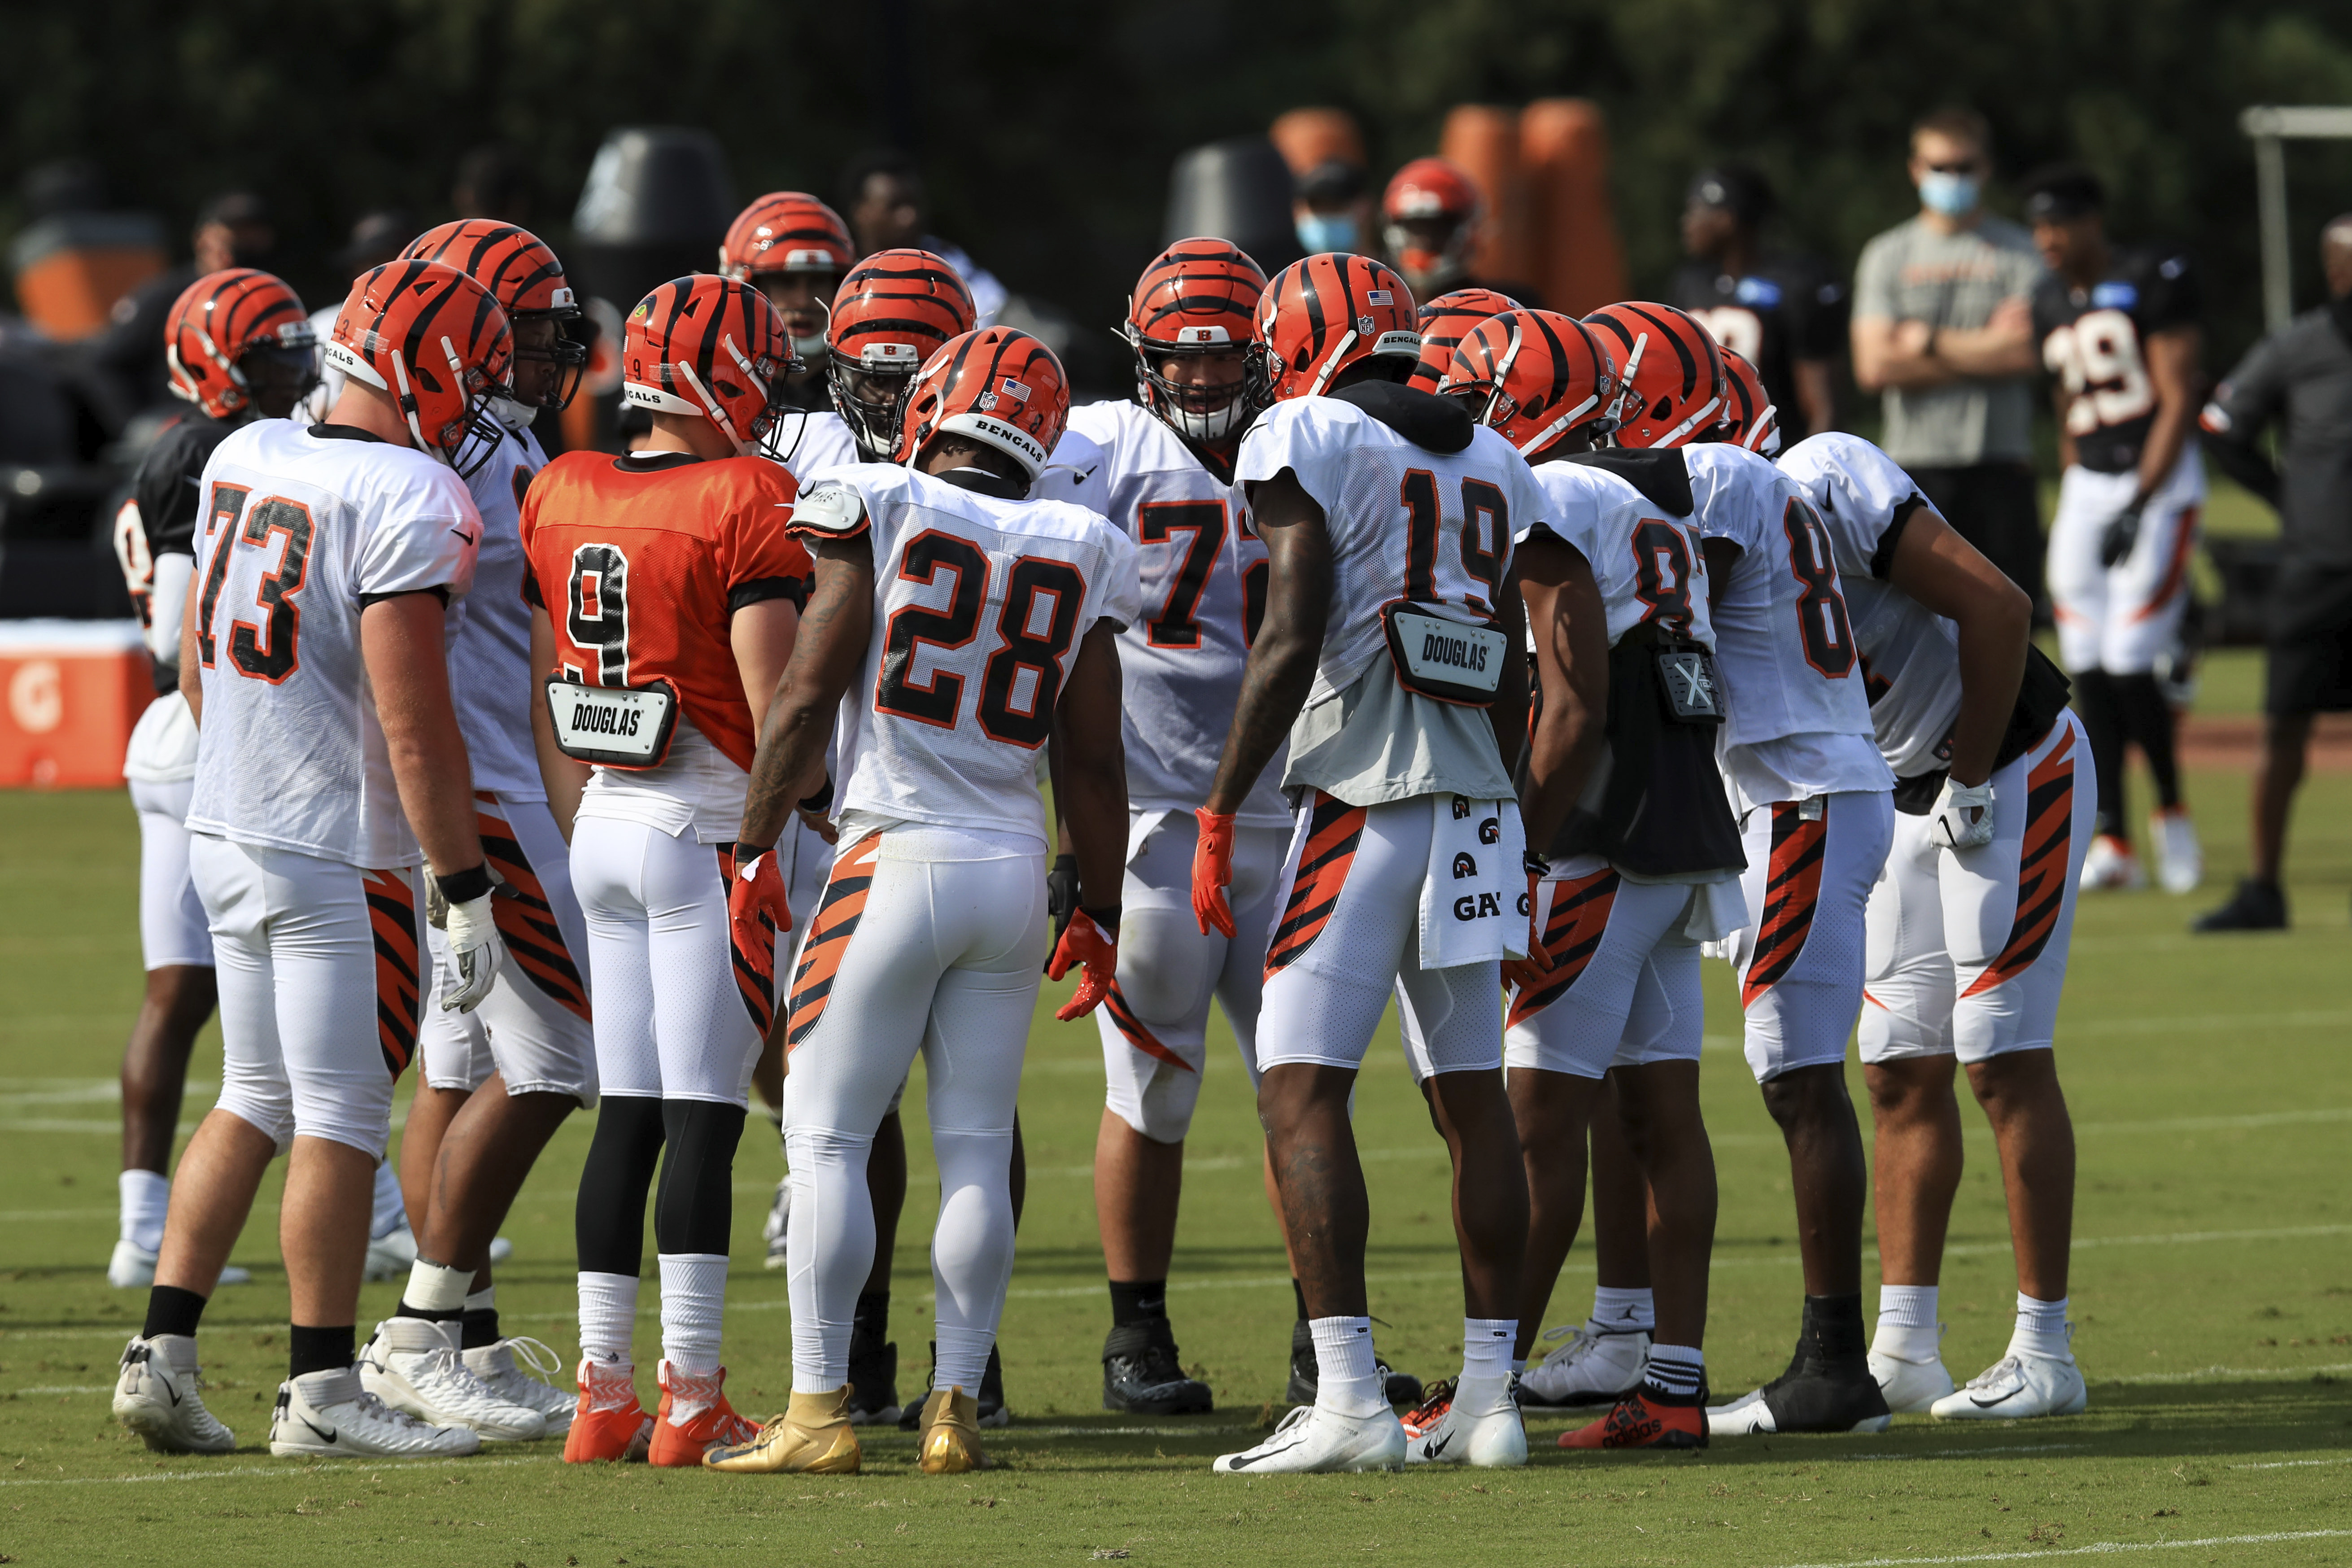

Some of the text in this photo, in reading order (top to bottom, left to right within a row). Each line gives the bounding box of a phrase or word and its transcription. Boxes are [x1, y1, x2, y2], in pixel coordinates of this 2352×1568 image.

[1197, 329, 1212, 341] B
[1361, 323, 1373, 333] NFL
[1389, 308, 1412, 331] 19
[883, 345, 896, 355] B
[1383, 336, 1421, 346] BENGALS
[633, 358, 642, 381] 9
[982, 398, 993, 409] NFL
[976, 420, 1043, 463] BENGALS
[1400, 467, 1509, 624] 19
[196, 480, 315, 686] 73
[1630, 517, 1712, 642] 8
[566, 542, 629, 687] 9
[875, 527, 1087, 751] 28
[1422, 633, 1488, 673] DOUGLAS
[8, 660, 63, 734] G
[571, 703, 641, 737] DOUGLAS
[1603, 1419, 1663, 1449] adidas
